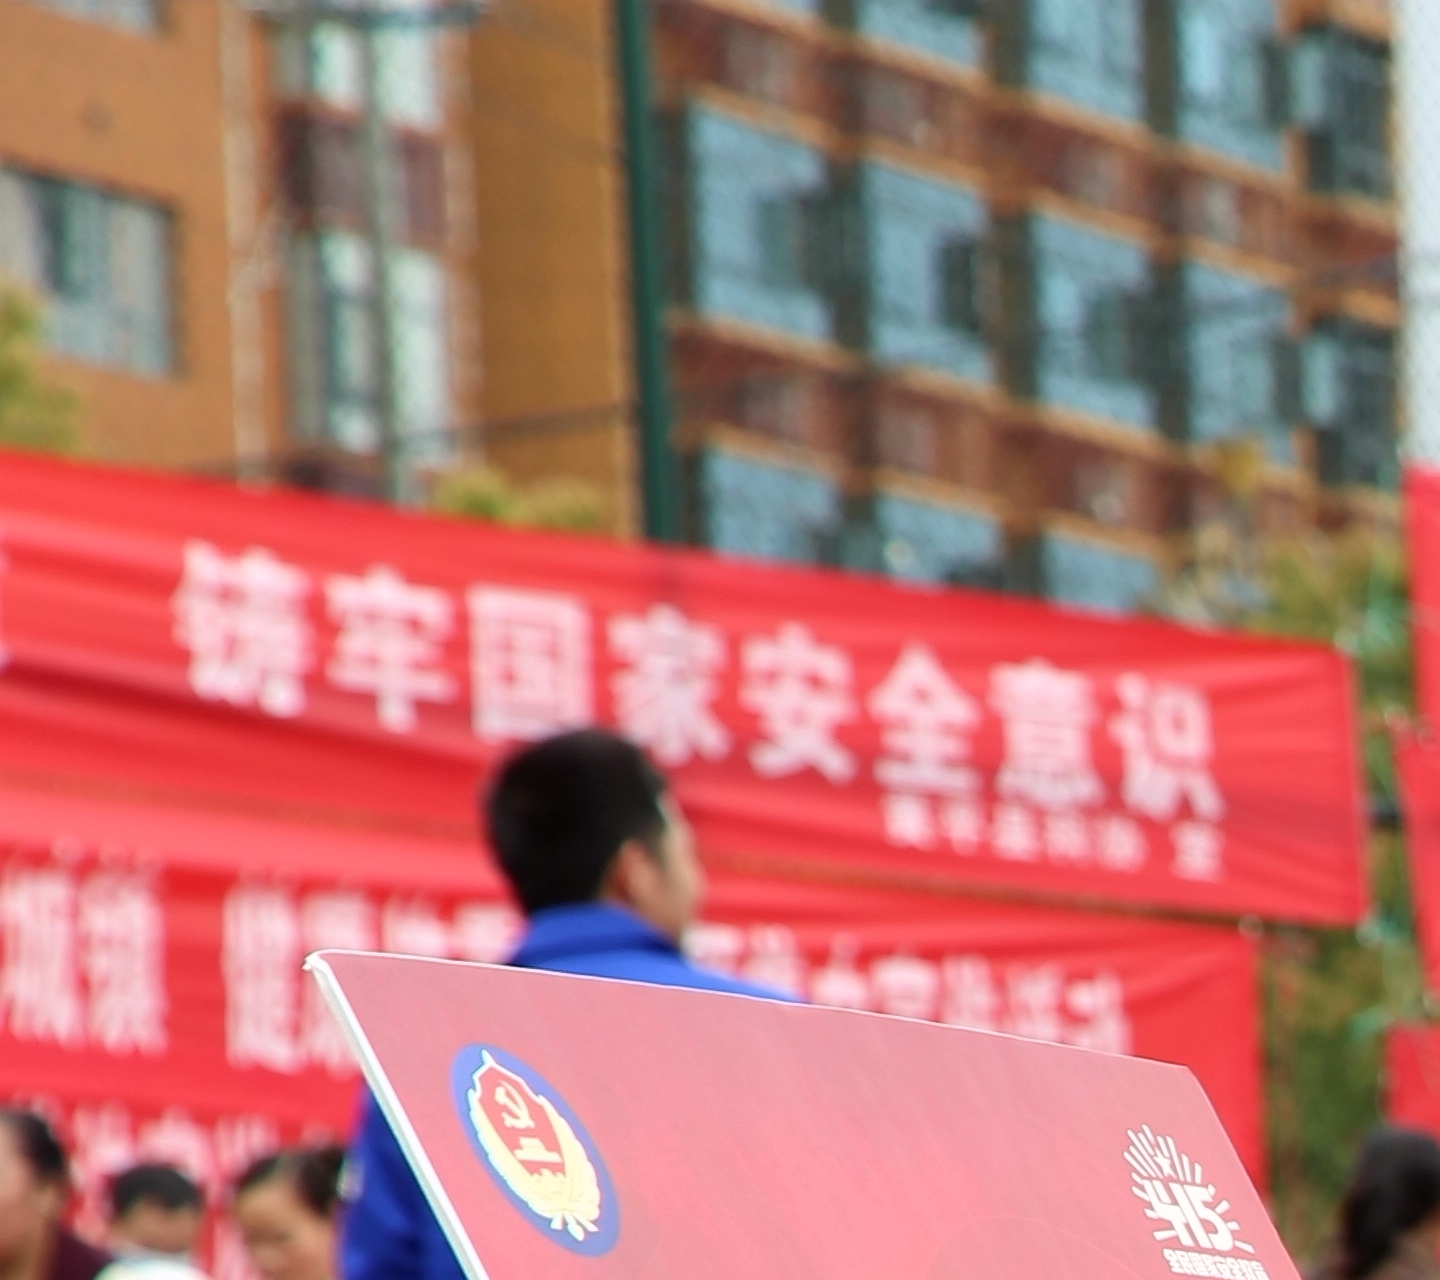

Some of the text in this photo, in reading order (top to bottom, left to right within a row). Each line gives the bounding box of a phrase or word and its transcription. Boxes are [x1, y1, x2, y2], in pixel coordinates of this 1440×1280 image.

[173, 541, 1224, 822] 铸牢国家安全意识
